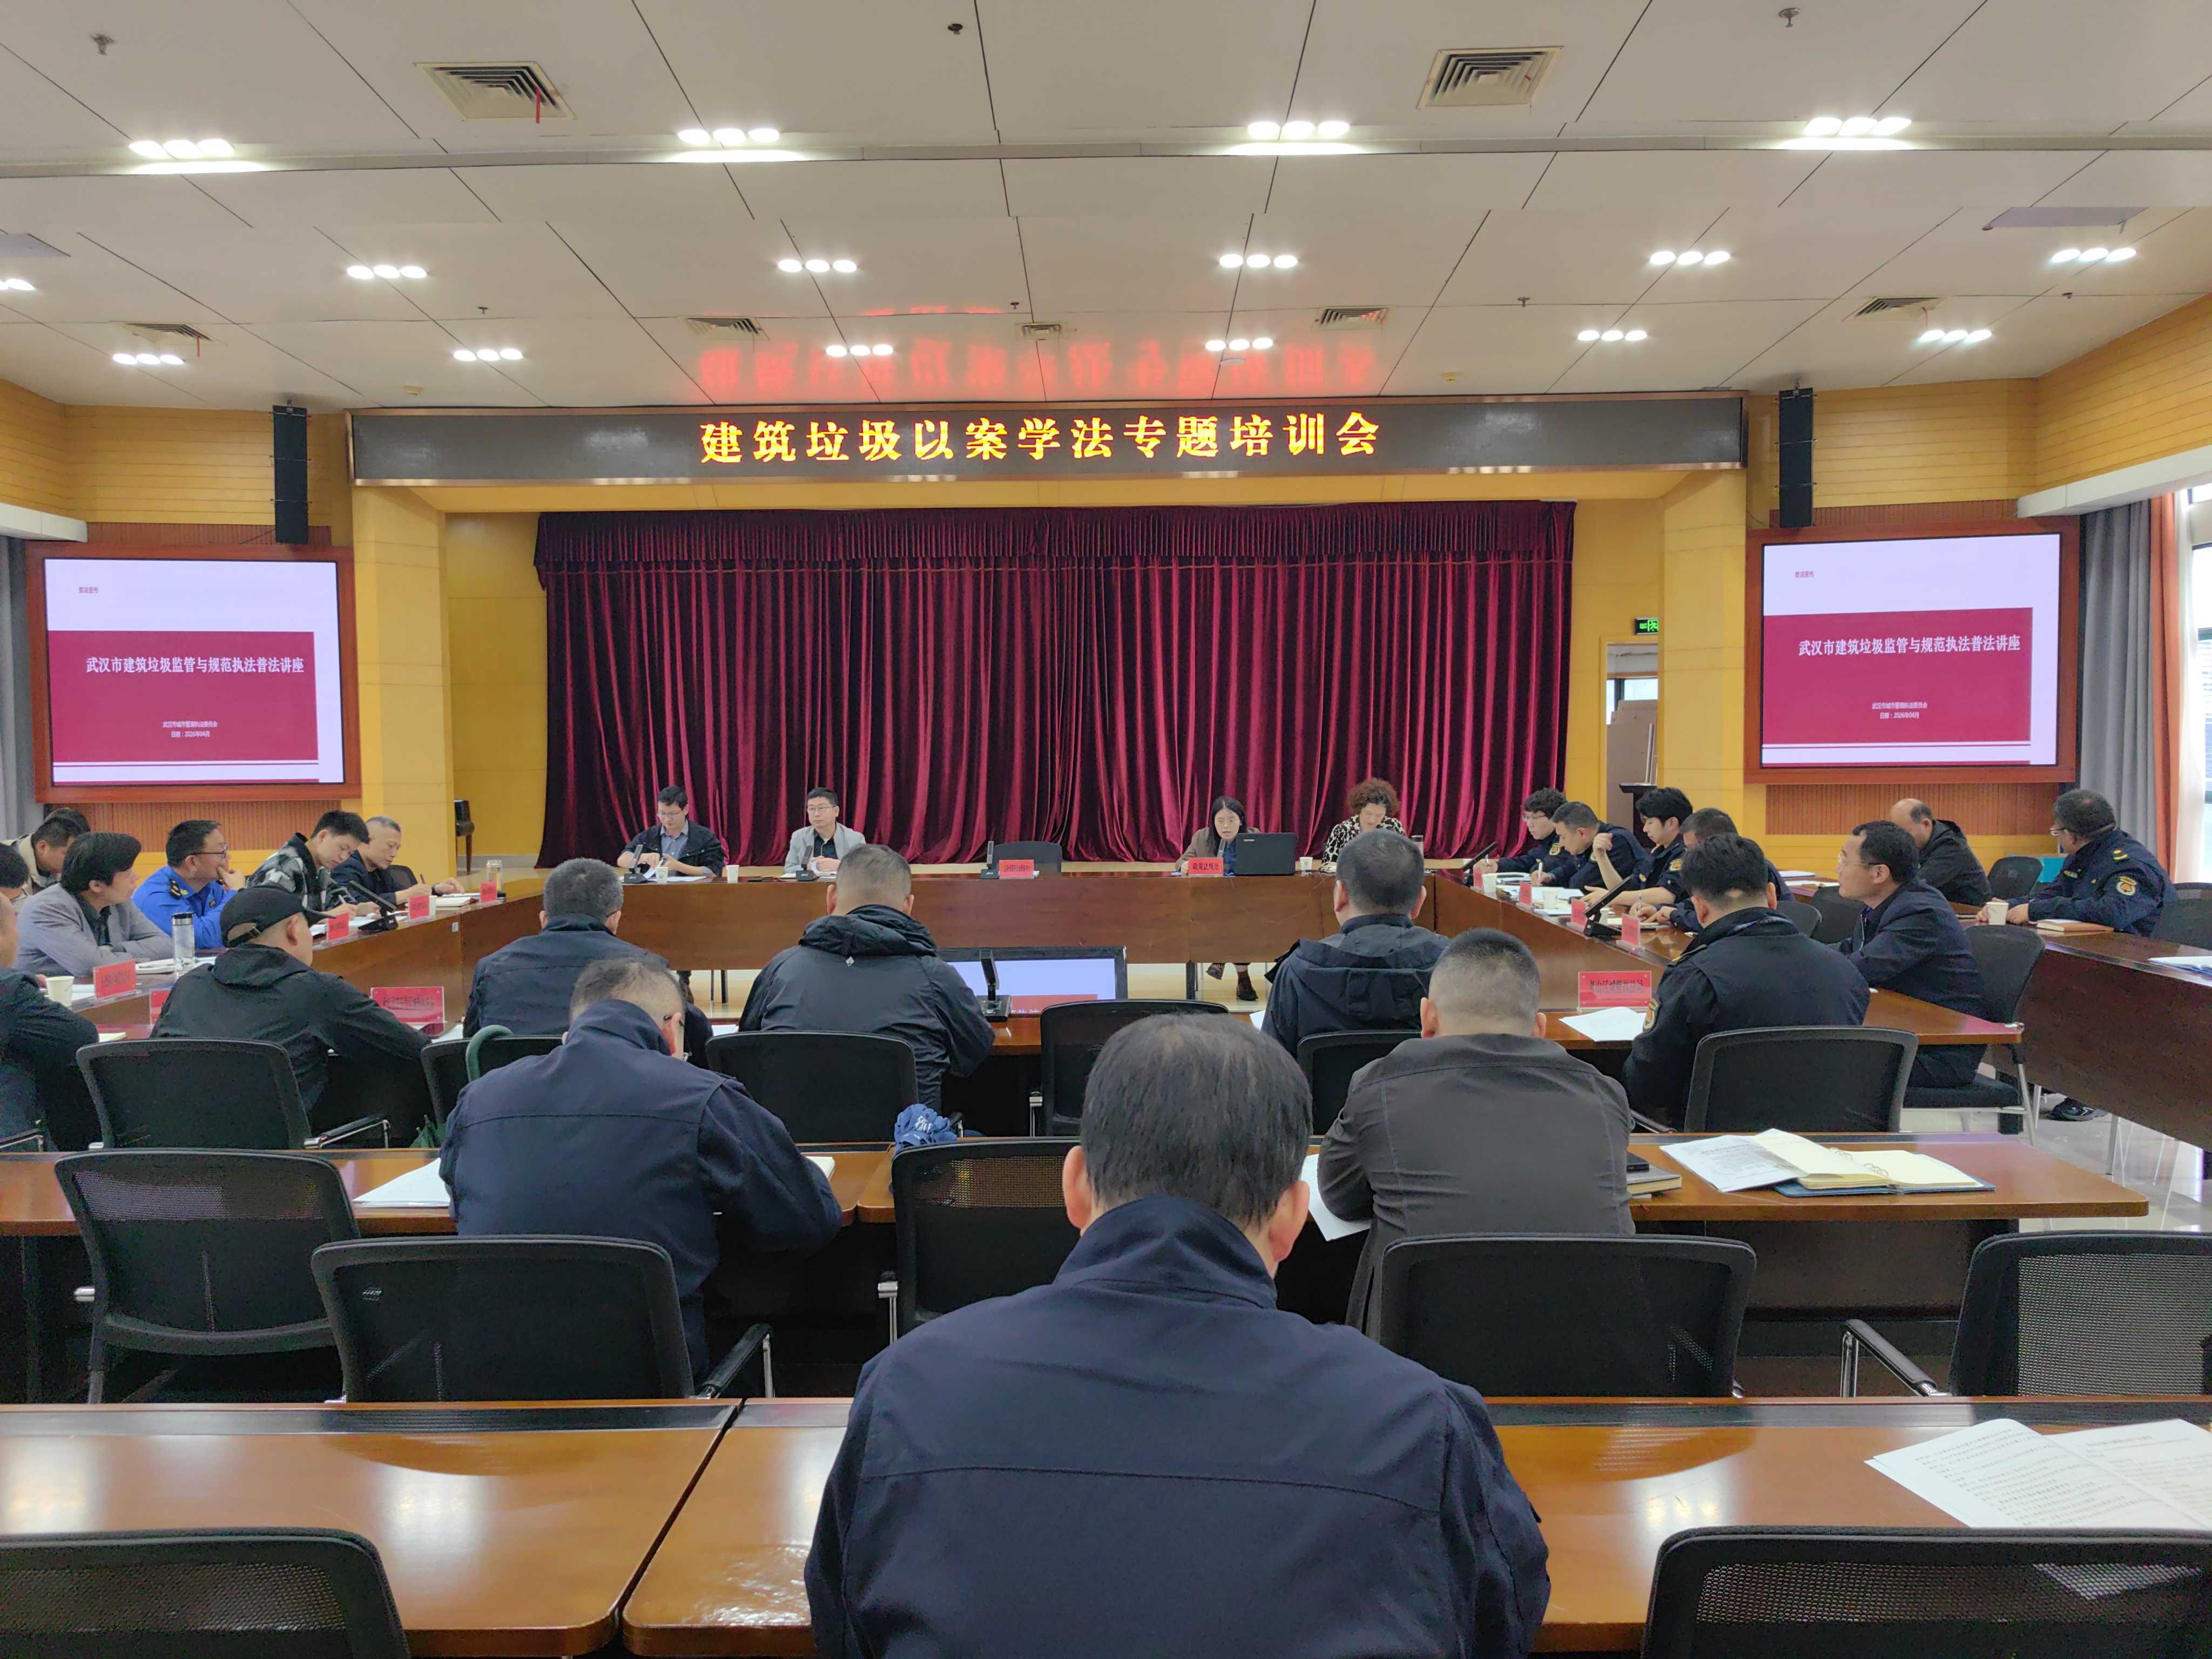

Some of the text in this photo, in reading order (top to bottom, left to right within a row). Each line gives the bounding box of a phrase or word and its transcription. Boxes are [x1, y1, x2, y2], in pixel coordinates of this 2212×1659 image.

[700, 412, 1379, 463] 建筑垃圾以案学法专题培训会
[1798, 635, 2020, 656] 武汉市建筑垃圾监管与规范执法普法讲座
[86, 657, 304, 673] 武汉市建筑垃圾监管与规范执法普法讲座
